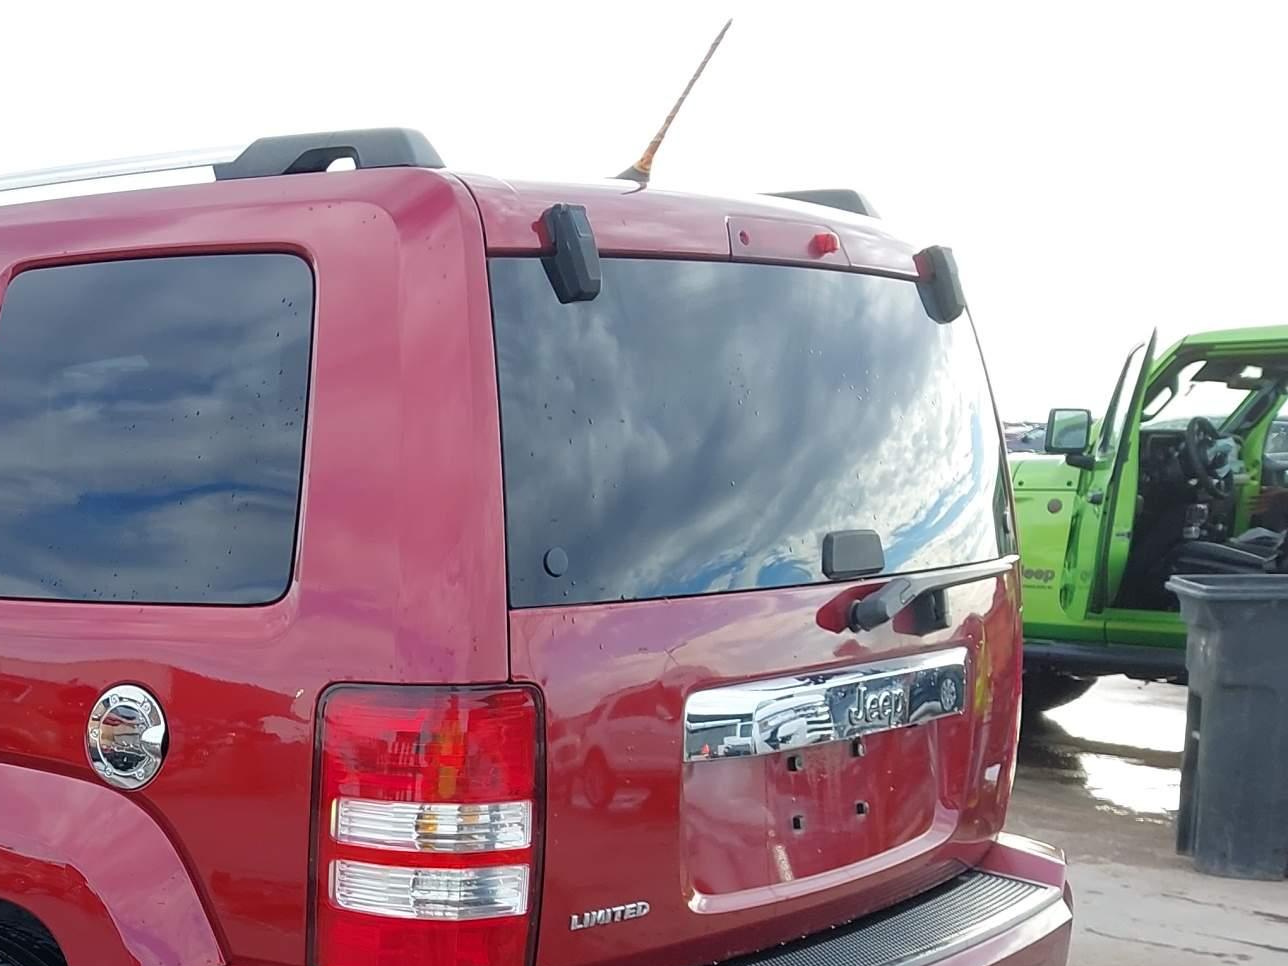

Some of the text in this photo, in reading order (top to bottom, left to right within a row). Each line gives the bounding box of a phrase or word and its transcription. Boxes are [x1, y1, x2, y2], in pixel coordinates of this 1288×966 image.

[1021, 565, 1055, 583] eep
[848, 683, 904, 728] Jeep
[571, 901, 650, 931] LIMITED
